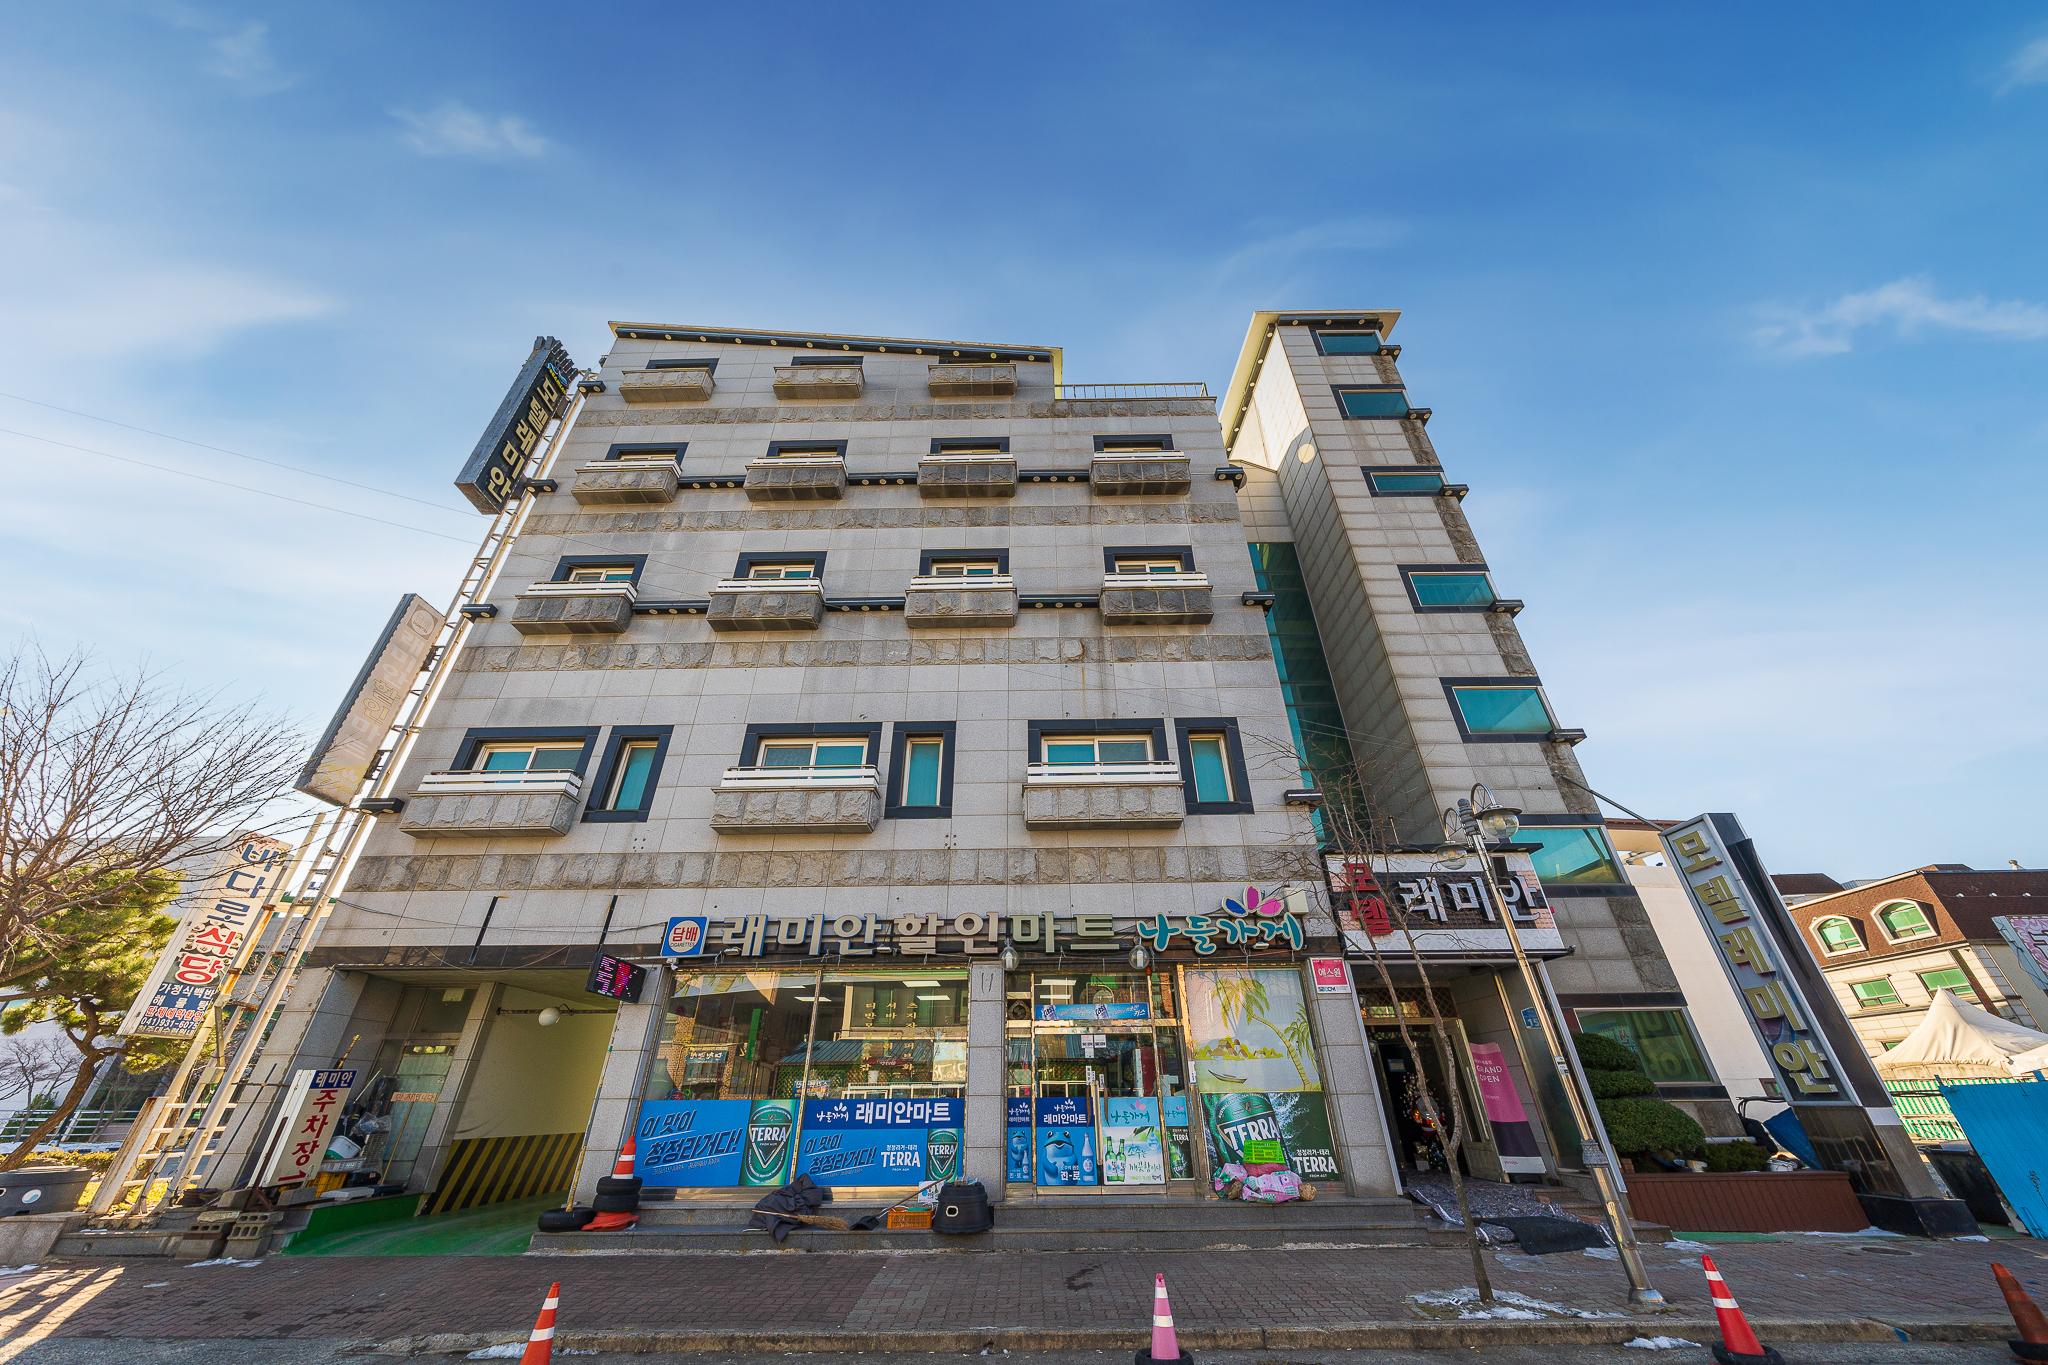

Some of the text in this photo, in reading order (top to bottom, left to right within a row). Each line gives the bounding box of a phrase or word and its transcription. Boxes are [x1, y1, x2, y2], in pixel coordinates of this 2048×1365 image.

[1343, 863, 1394, 935] 모텔
[1398, 875, 1541, 923] 래미안
[672, 927, 698, 942] 담배
[1136, 912, 1304, 955] 나들가게
[1318, 967, 1341, 978] 에스원
[159, 983, 217, 999] 가정식백반
[315, 1072, 353, 1087] 래미안
[855, 1101, 951, 1124] 래미안마트
[1043, 1113, 1087, 1125] 래미안마트
[292, 1090, 338, 1167] 주차장
[640, 1109, 698, 1137] 이 맛이
[751, 1126, 787, 1142] TERRA
[1224, 1116, 1281, 1150] TERRA
[930, 1144, 955, 1156] TERRA
[881, 1152, 921, 1168] TERRA
[1293, 1157, 1338, 1174] TERRA
